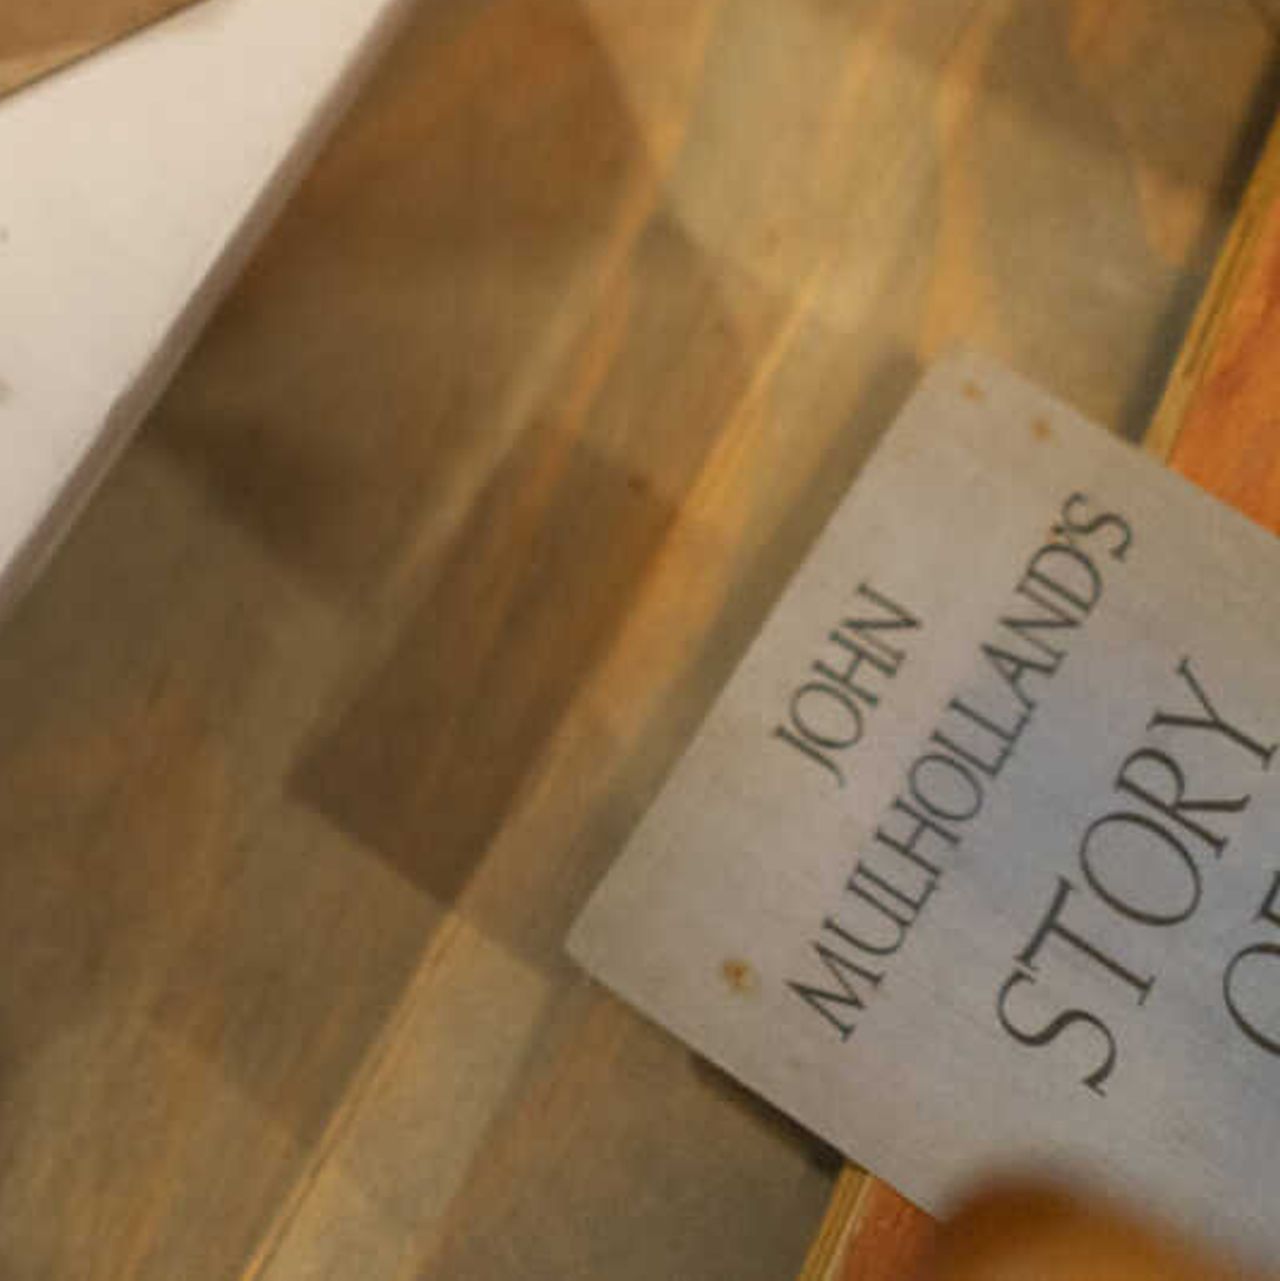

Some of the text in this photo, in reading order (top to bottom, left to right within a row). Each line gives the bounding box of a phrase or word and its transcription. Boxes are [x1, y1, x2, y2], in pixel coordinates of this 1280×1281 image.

[771, 582, 924, 787] JOHN
[786, 493, 1135, 1041] MULHOLLAND'S
[997, 658, 1278, 1097] STORY
